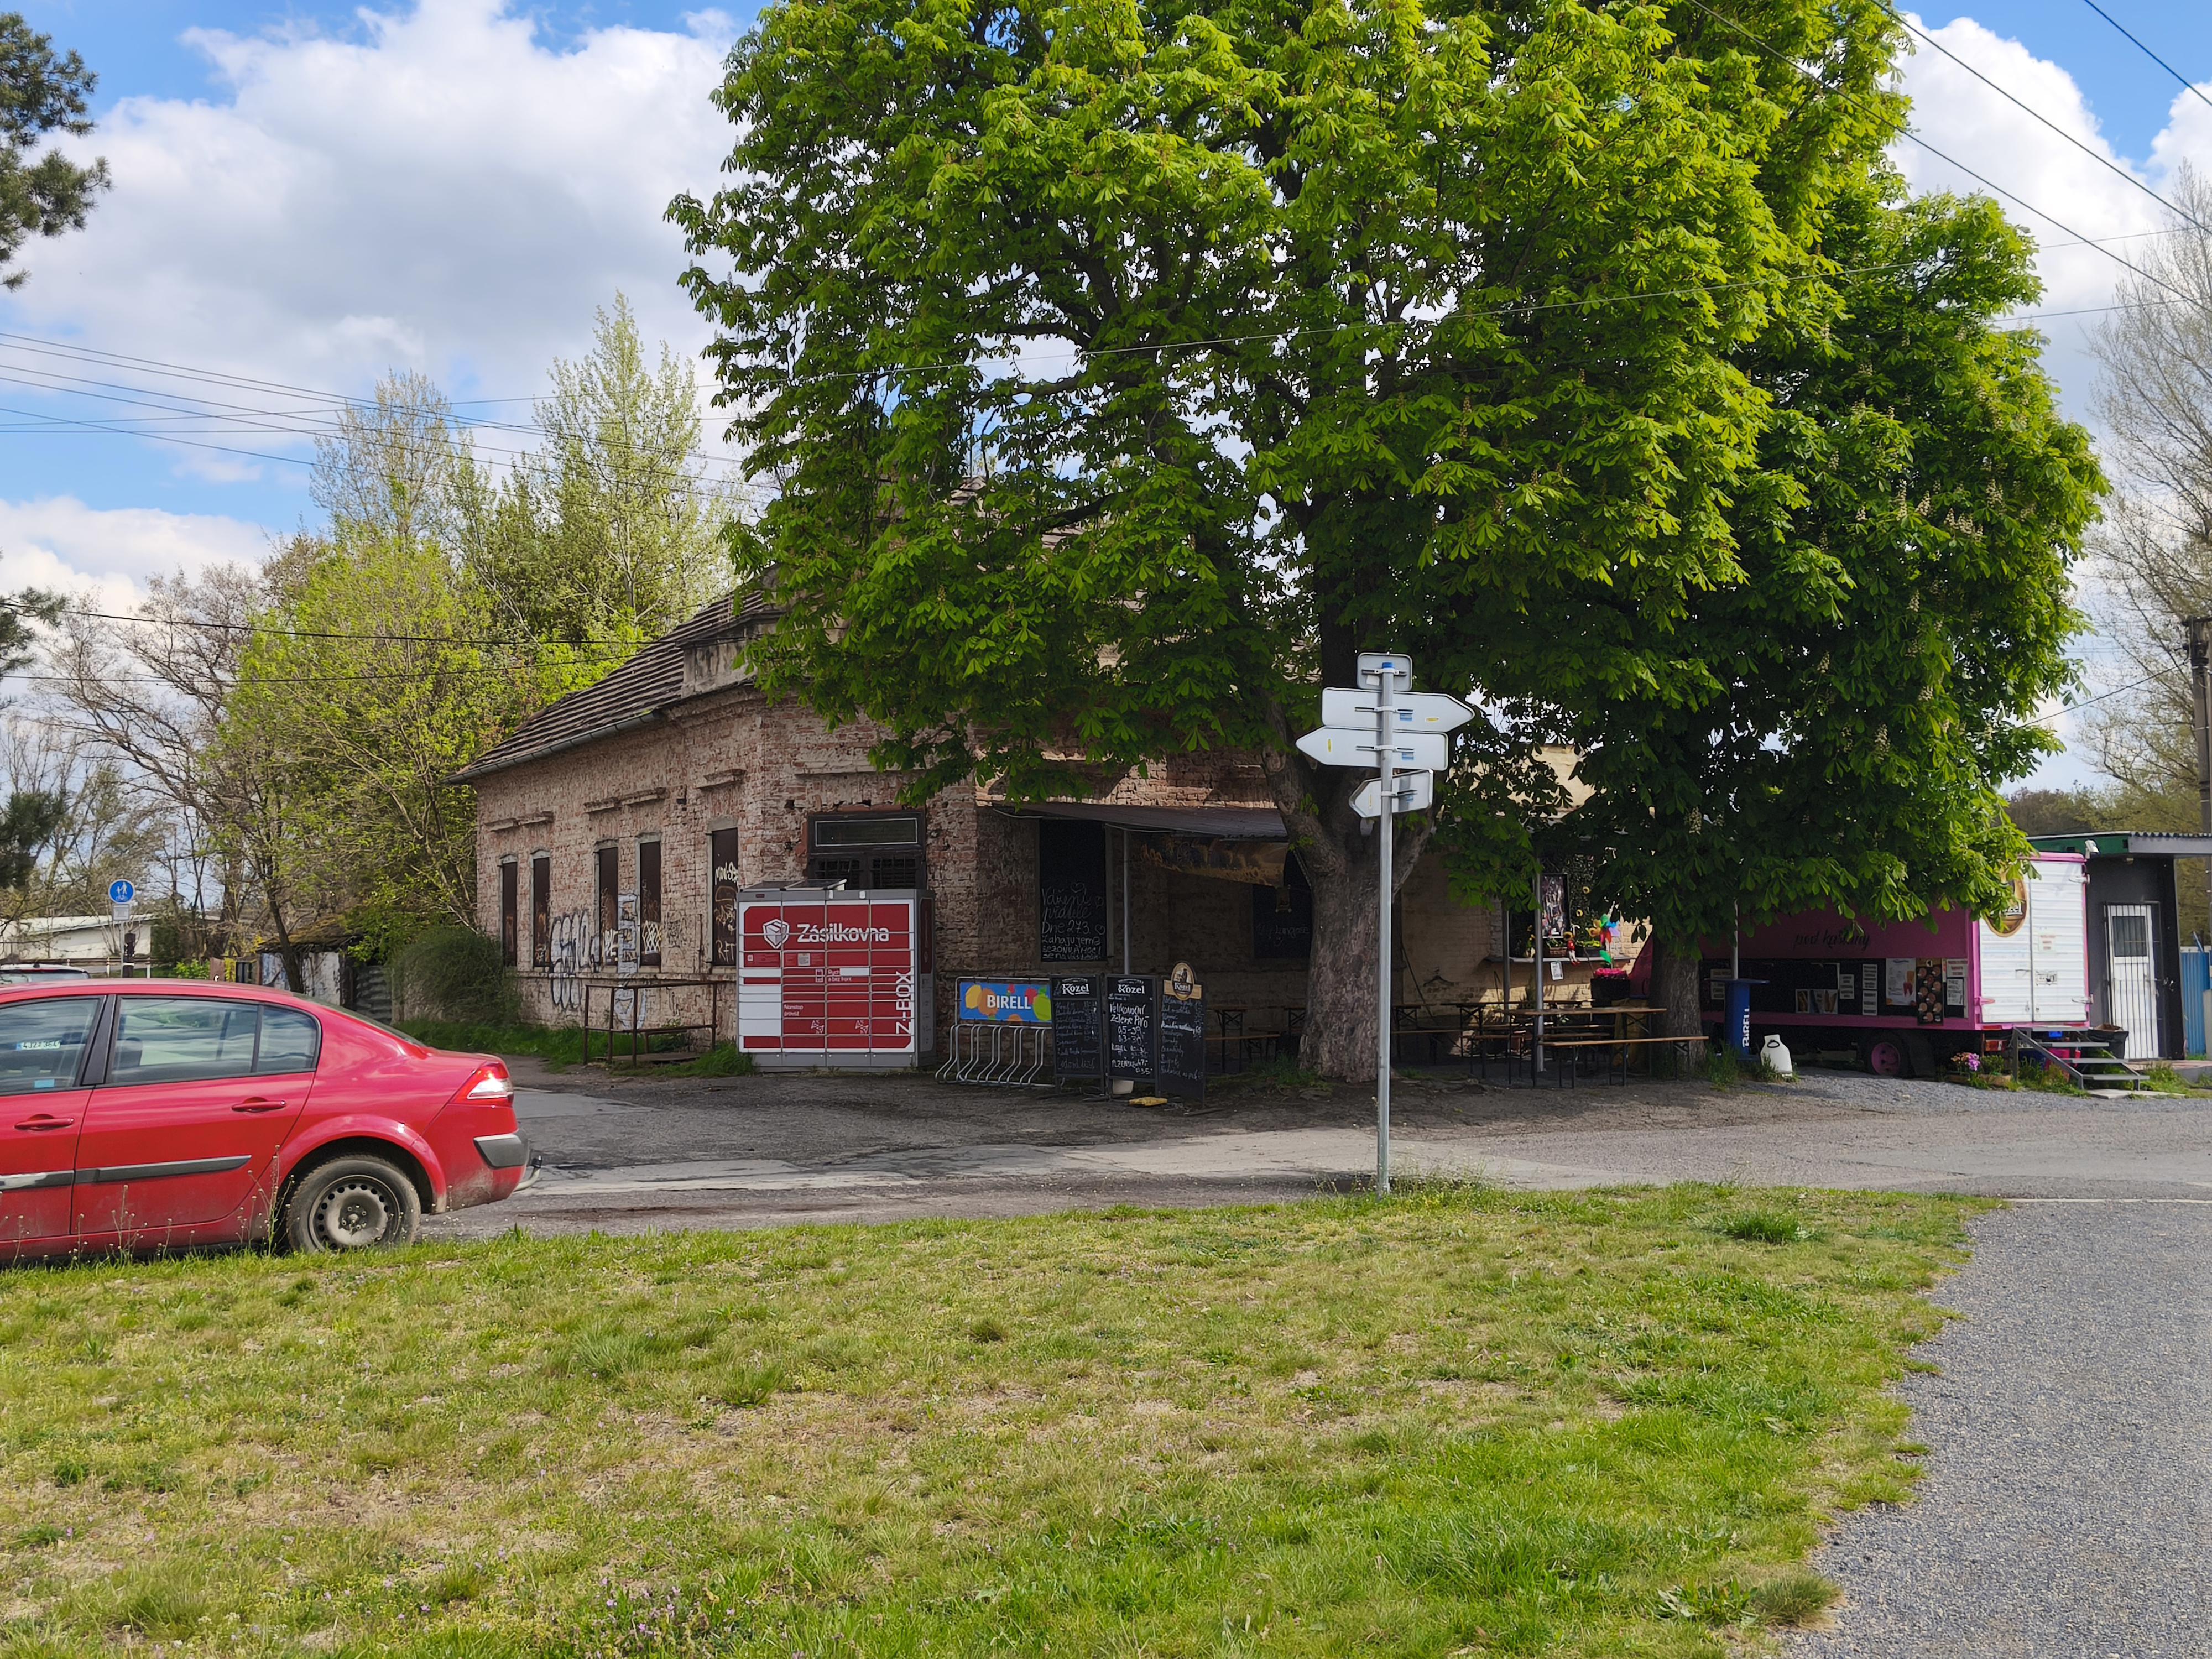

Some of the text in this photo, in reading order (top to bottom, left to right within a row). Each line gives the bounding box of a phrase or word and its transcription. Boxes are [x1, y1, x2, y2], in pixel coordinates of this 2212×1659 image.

[797, 922, 890, 942] Zásilkovna
[1041, 921, 1065, 934] Dne
[1062, 983, 1090, 995] Kozel
[1117, 984, 1145, 994] Kozel
[895, 970, 911, 1035] Z-BOX
[986, 994, 1032, 1010] BIRELL
